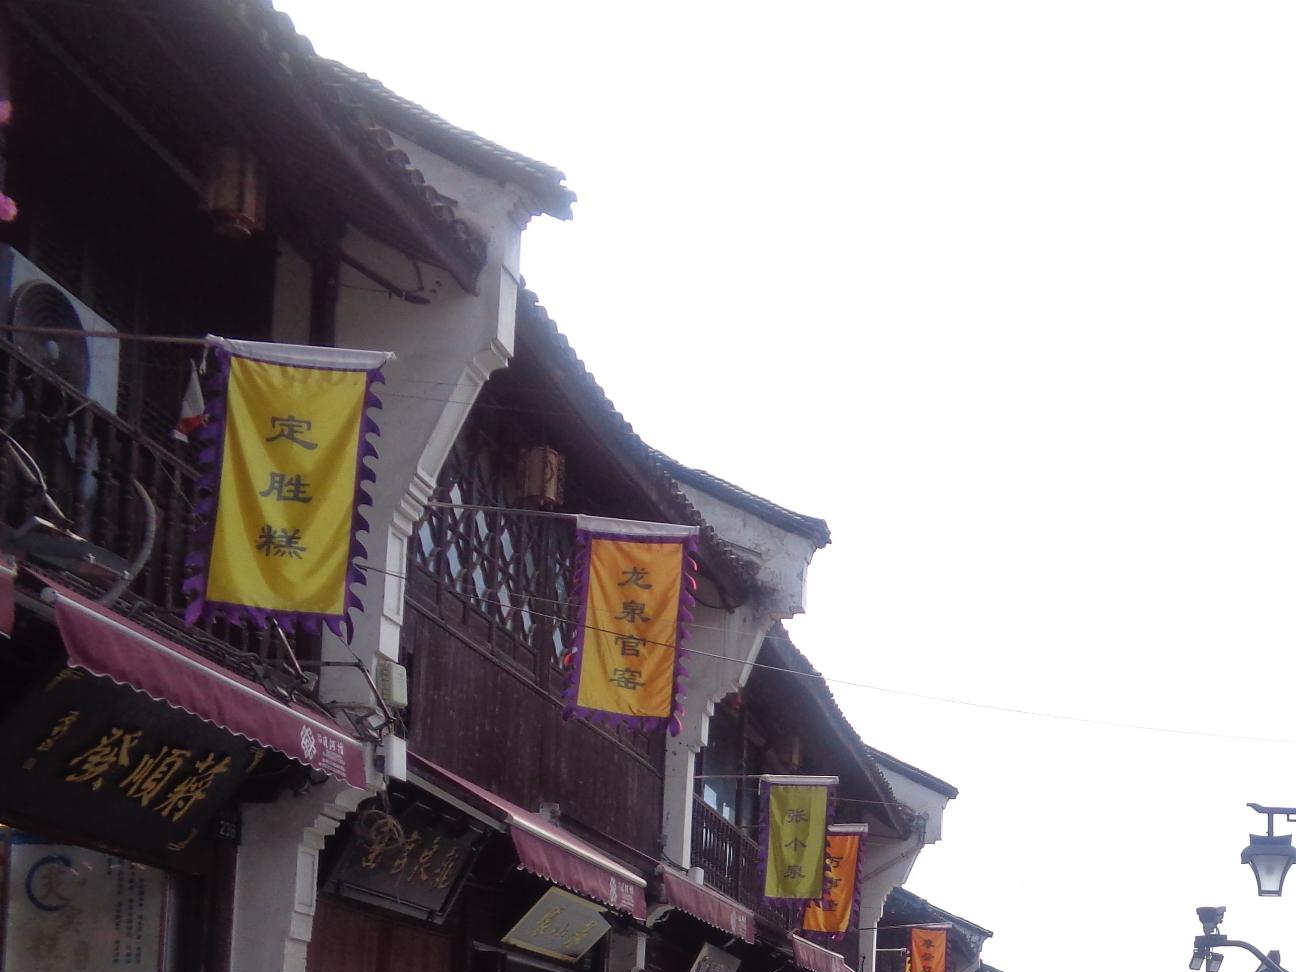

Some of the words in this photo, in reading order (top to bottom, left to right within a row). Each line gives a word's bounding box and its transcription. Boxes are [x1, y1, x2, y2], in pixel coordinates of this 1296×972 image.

[256, 414, 318, 561] 定胜糕
[608, 566, 652, 691] 龙泉官窑
[784, 810, 809, 879] 张小泉
